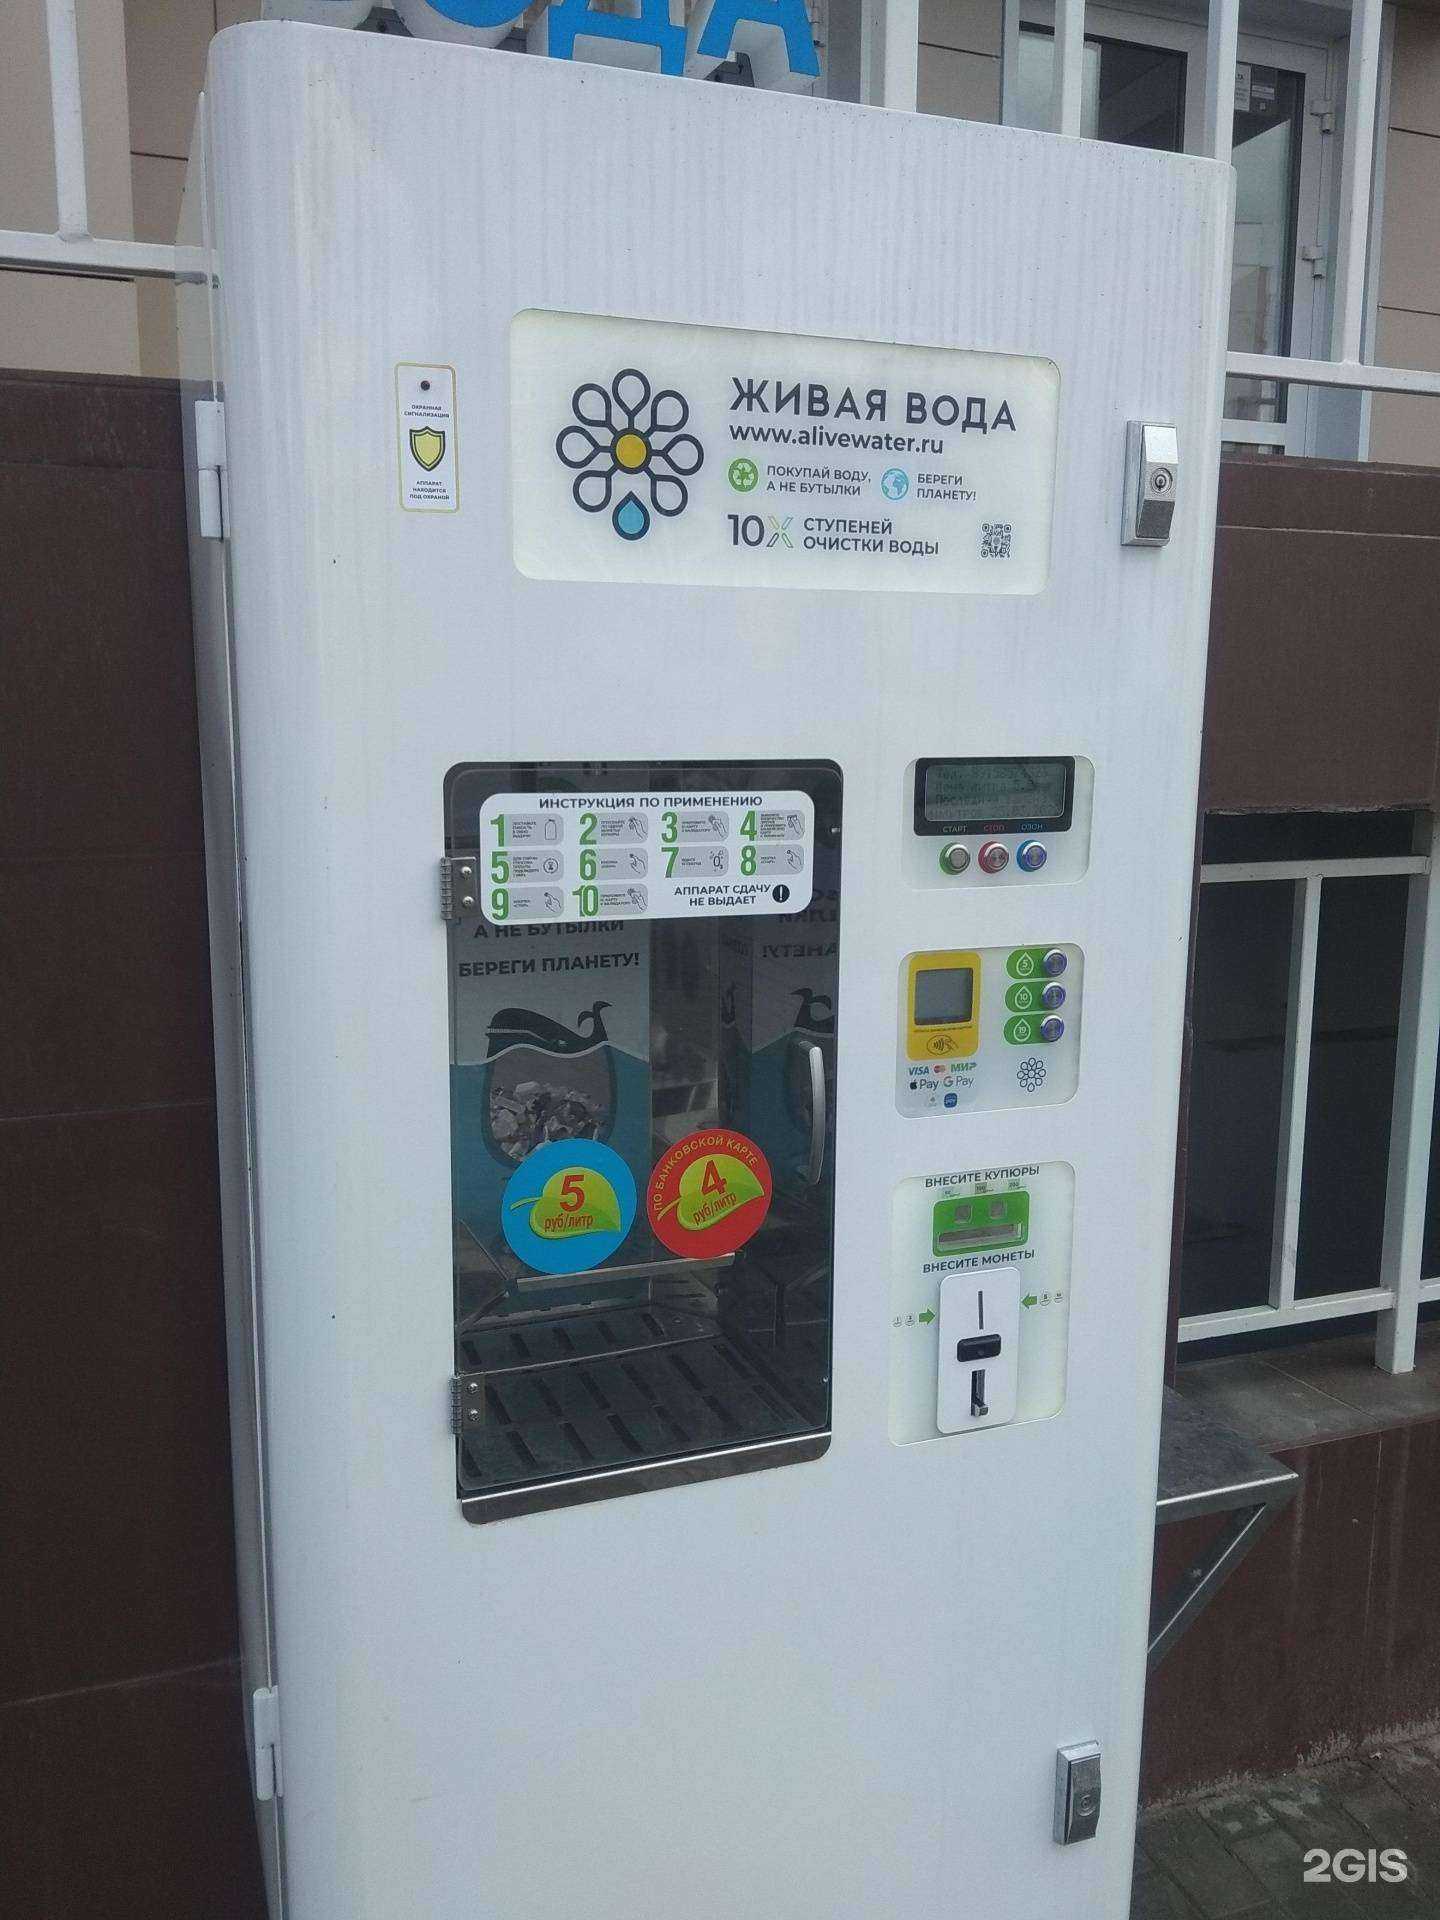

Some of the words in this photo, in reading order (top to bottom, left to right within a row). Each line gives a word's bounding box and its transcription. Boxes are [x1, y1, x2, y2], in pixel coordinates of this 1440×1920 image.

[729, 376, 887, 422] ЖИВАЯ
[905, 391, 1016, 435] ВОДА
[729, 424, 944, 455] www.alivewater.ru
[767, 464, 830, 480] ПОКУПАЙ
[834, 469, 872, 483] ВОДУ,
[918, 473, 963, 486] БЕРЕГИ
[767, 482, 776, 492] А
[779, 482, 797, 492] НЕ
[800, 483, 861, 496] БУТЫЛКИ
[917, 488, 977, 502] ПЛАНЕТУ!
[803, 517, 892, 535] СТУПЕНЕЙ
[803, 537, 883, 553] ОЧИСТКИ
[889, 540, 939, 556] ВОДЫ
[539, 797, 635, 810] ИНСТРУКЦИЯ
[639, 797, 660, 808] ПО
[664, 796, 763, 808] ПРИМЕНЕНИЮ
[490, 813, 505, 848] 1
[579, 812, 598, 846] 2
[661, 811, 678, 843] 3
[740, 810, 757, 842] 4
[491, 850, 510, 885] 5
[579, 848, 597, 881] 6
[661, 846, 680, 879] 7
[740, 845, 757, 877] 8
[571, 884, 599, 917] 10
[674, 884, 730, 897] АППАРАТ
[732, 883, 772, 896] СДАЧУ
[688, 897, 706, 907] НЕ
[708, 895, 756, 908] ВЫДАЕТ
[491, 887, 509, 921] 9
[473, 923, 489, 939] А
[495, 924, 522, 939] НЕ
[527, 919, 624, 937] БУТЫЛКИ
[458, 958, 536, 978] БЕРЕГИ
[541, 952, 640, 973] ПЛАНЕТУ!
[908, 1066, 930, 1076] VISA
[956, 1075, 975, 1089] Pay
[919, 1078, 939, 1092] Pay
[654, 1134, 724, 1191] БАНКОВСКОЙ
[726, 1136, 759, 1166] КАРТЕ
[701, 1159, 728, 1196] 4
[925, 1172, 981, 1188] ВНЕСИТЕ
[984, 1165, 1040, 1181] КУПЮРЫ
[559, 1174, 586, 1214] 5
[652, 1193, 664, 1211] ПО
[692, 1192, 738, 1227] руб/литр
[543, 1213, 594, 1233] руб/литр
[923, 1256, 979, 1274] ВНЕСИТЕ
[982, 1249, 1036, 1266] МОНЕТЫ
